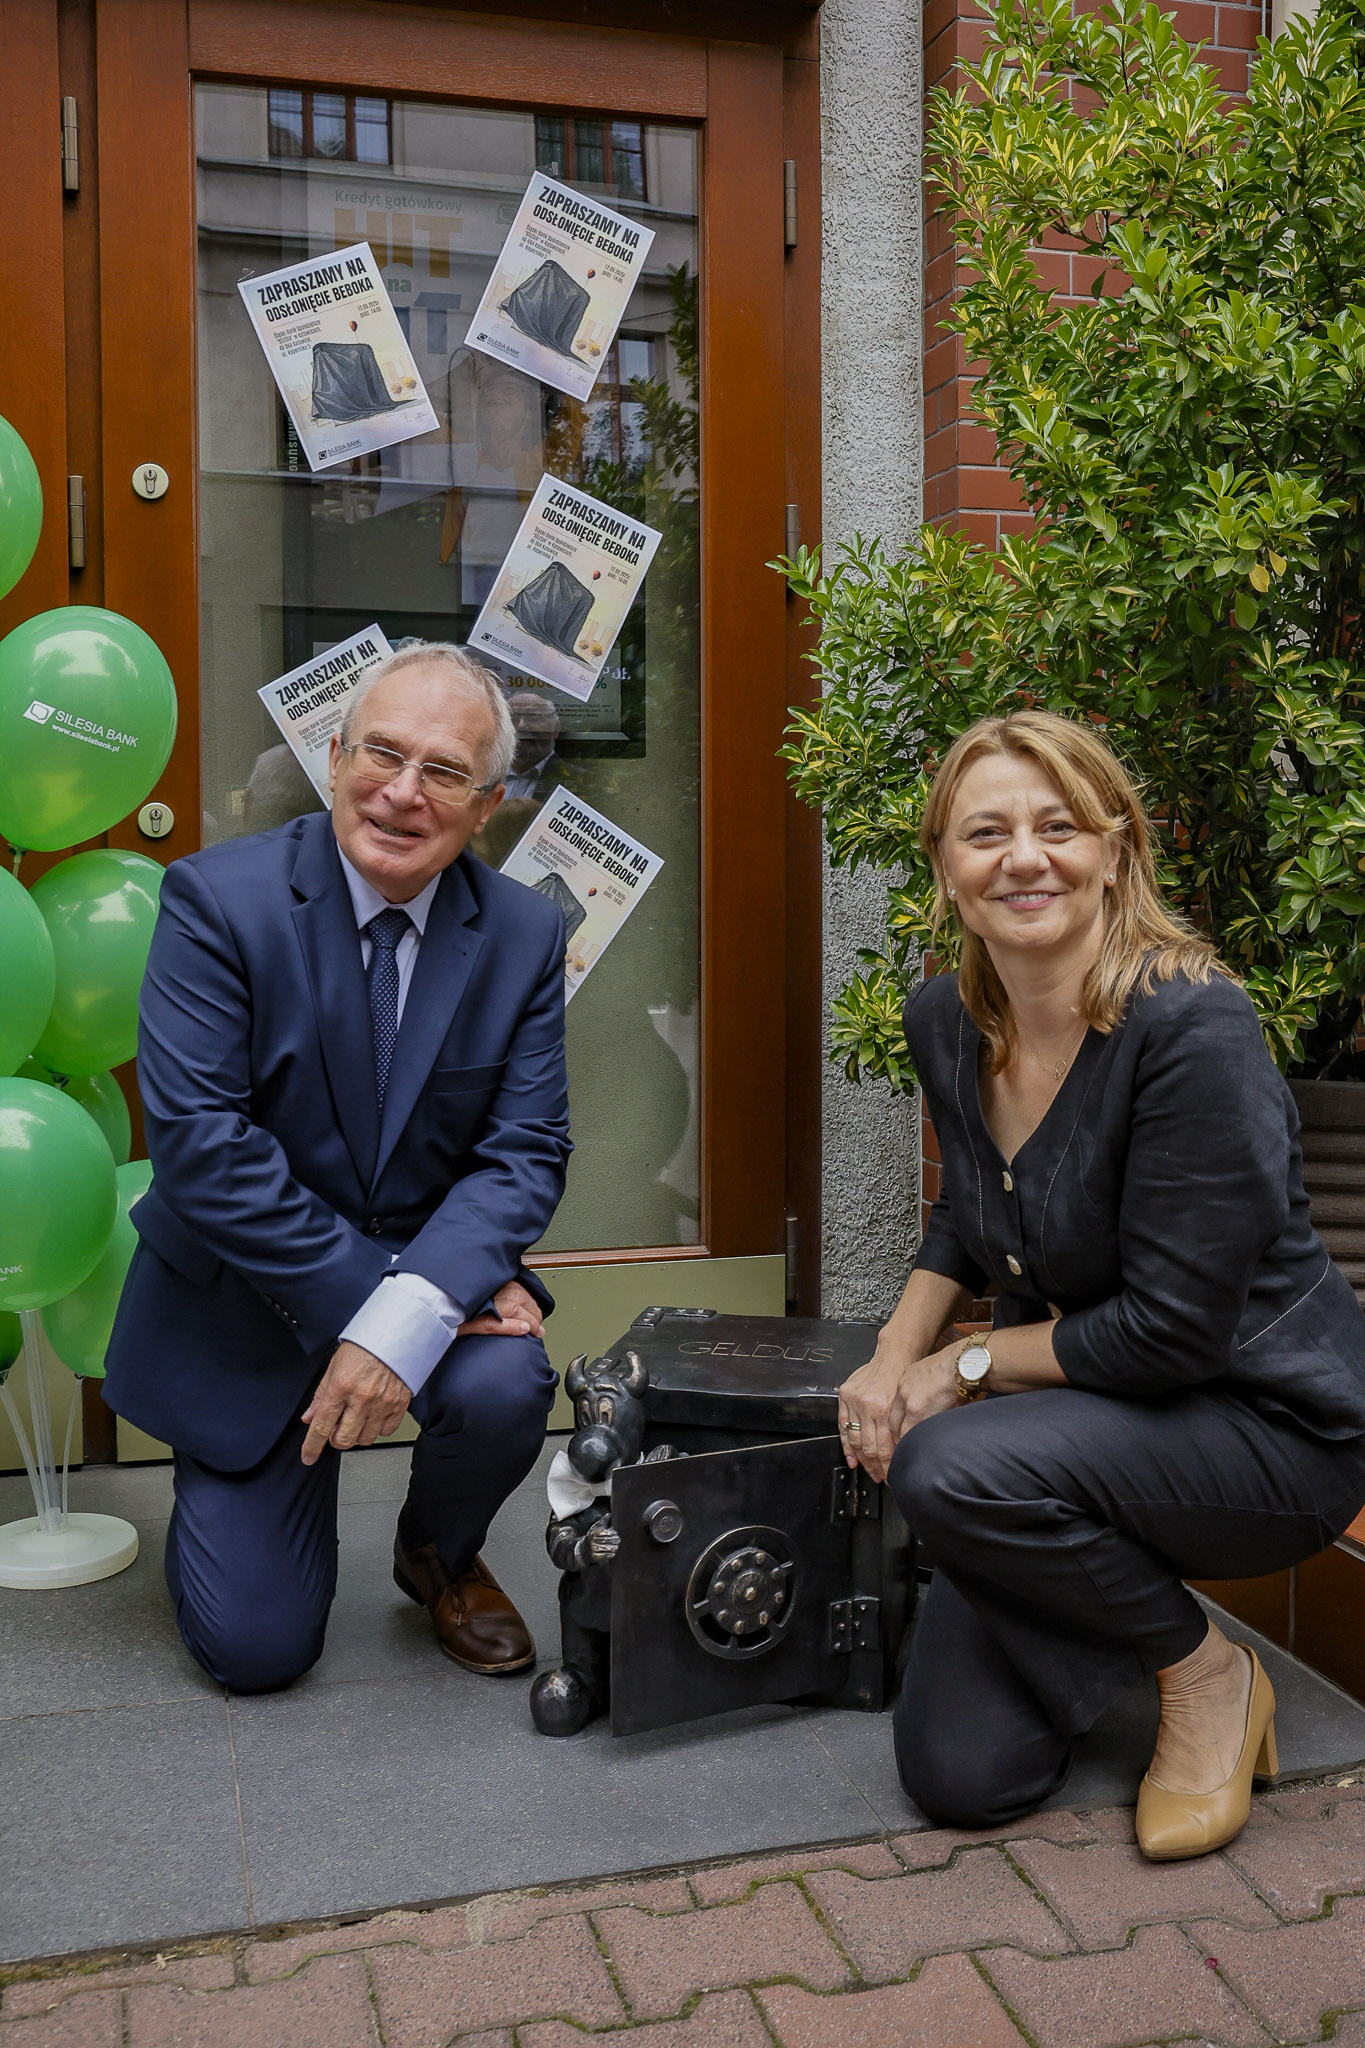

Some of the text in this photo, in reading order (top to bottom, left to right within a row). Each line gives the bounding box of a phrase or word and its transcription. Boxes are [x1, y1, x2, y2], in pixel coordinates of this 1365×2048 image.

[335, 190, 463, 214] Kredyt gotówkowy
[538, 186, 640, 248] ZAPRASZAMY NA
[533, 204, 633, 264] ODSŁONIĘCIE BEBOKA
[257, 257, 367, 306] ZAPRASZAMY NA
[265, 277, 374, 323] ODSŁONIĘCIE BEBOKA
[387, 277, 412, 293] na
[288, 416, 299, 472] AMSUNG
[541, 507, 639, 566] ODSŁONIĘCIE BEBOKA
[548, 489, 646, 551] ZAPRASZAMY NA
[275, 649, 357, 706] ZAPRASZAMY
[356, 639, 379, 660] NA
[506, 675, 524, 688] 30
[286, 678, 350, 721] ODSŁONIĘCIE
[51, 723, 120, 753] www.silesiabank.pl
[55, 710, 139, 748] SILESIA BANK
[547, 817, 639, 888] ODSŁONIĘCIE BEBOKA
[556, 800, 649, 874] ZAPRASZAMY NA
[678, 1341, 834, 1363] GELDUS
